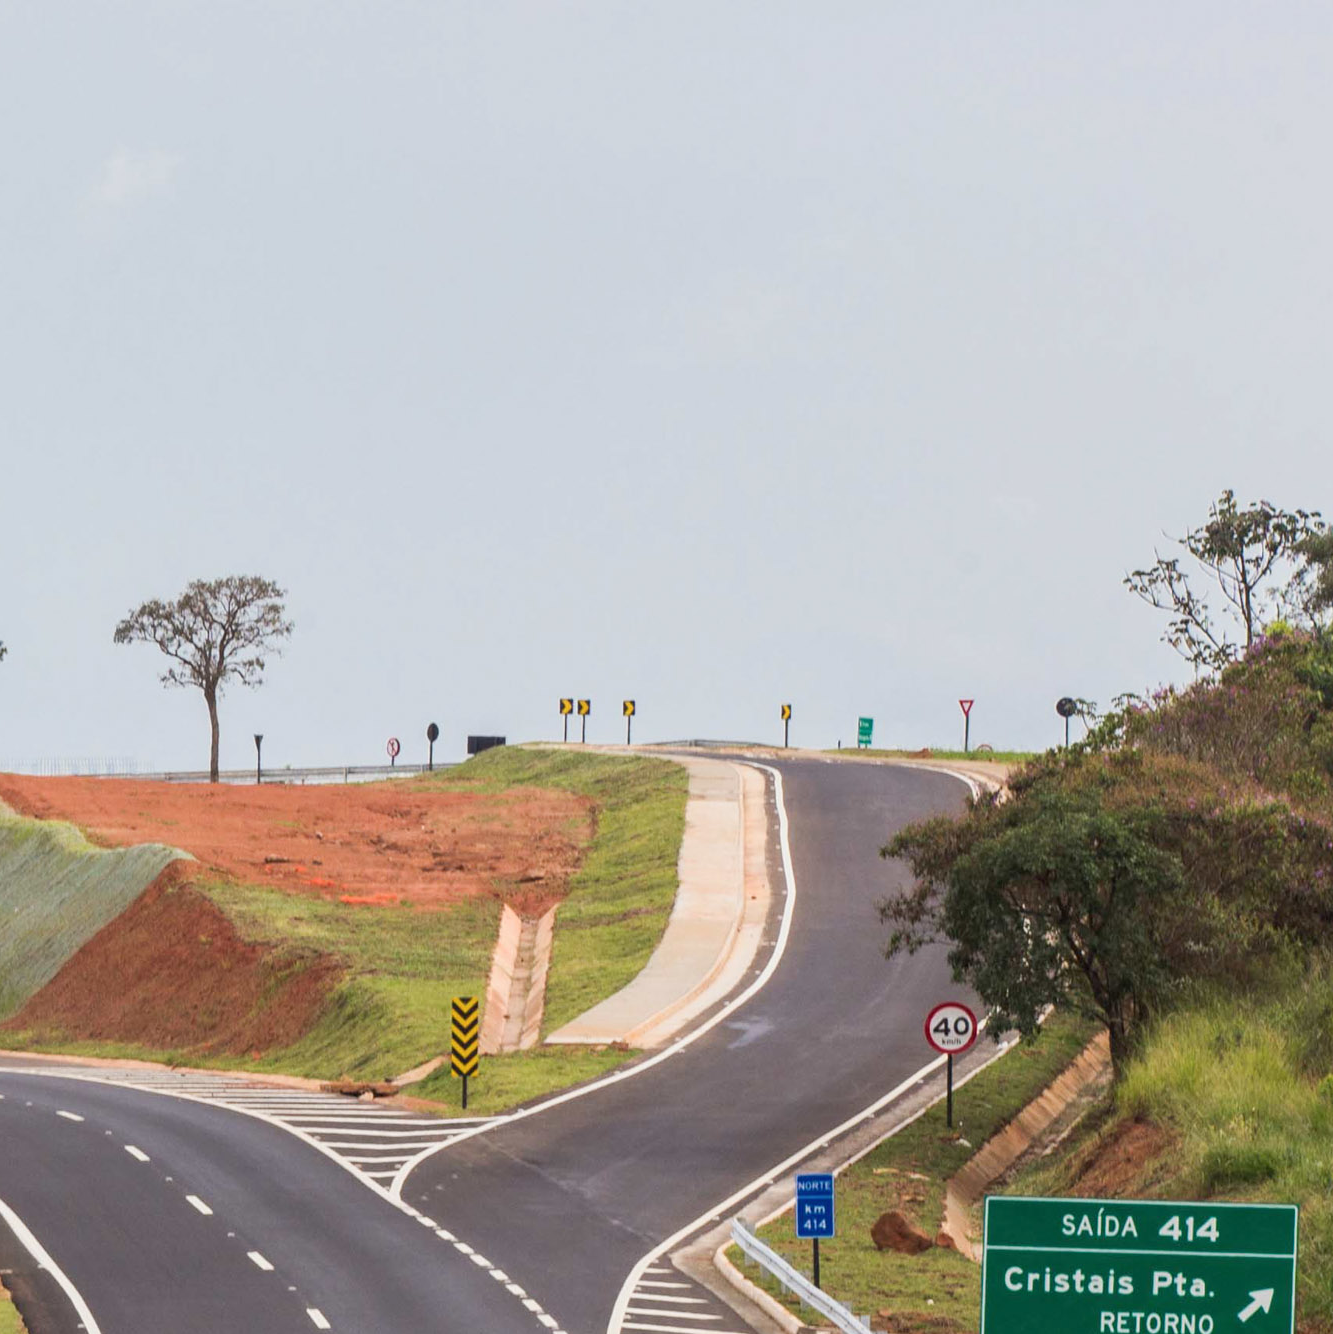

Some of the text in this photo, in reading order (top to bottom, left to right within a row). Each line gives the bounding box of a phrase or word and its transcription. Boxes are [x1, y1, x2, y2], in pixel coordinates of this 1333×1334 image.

[933, 1016, 969, 1036] 40
[798, 1181, 830, 1190] NORTE
[805, 1204, 826, 1214] km
[804, 1219, 827, 1229] 414
[1062, 1207, 1220, 1242] SAÍDA 414
[1004, 1266, 1215, 1298] Cristais Pta.
